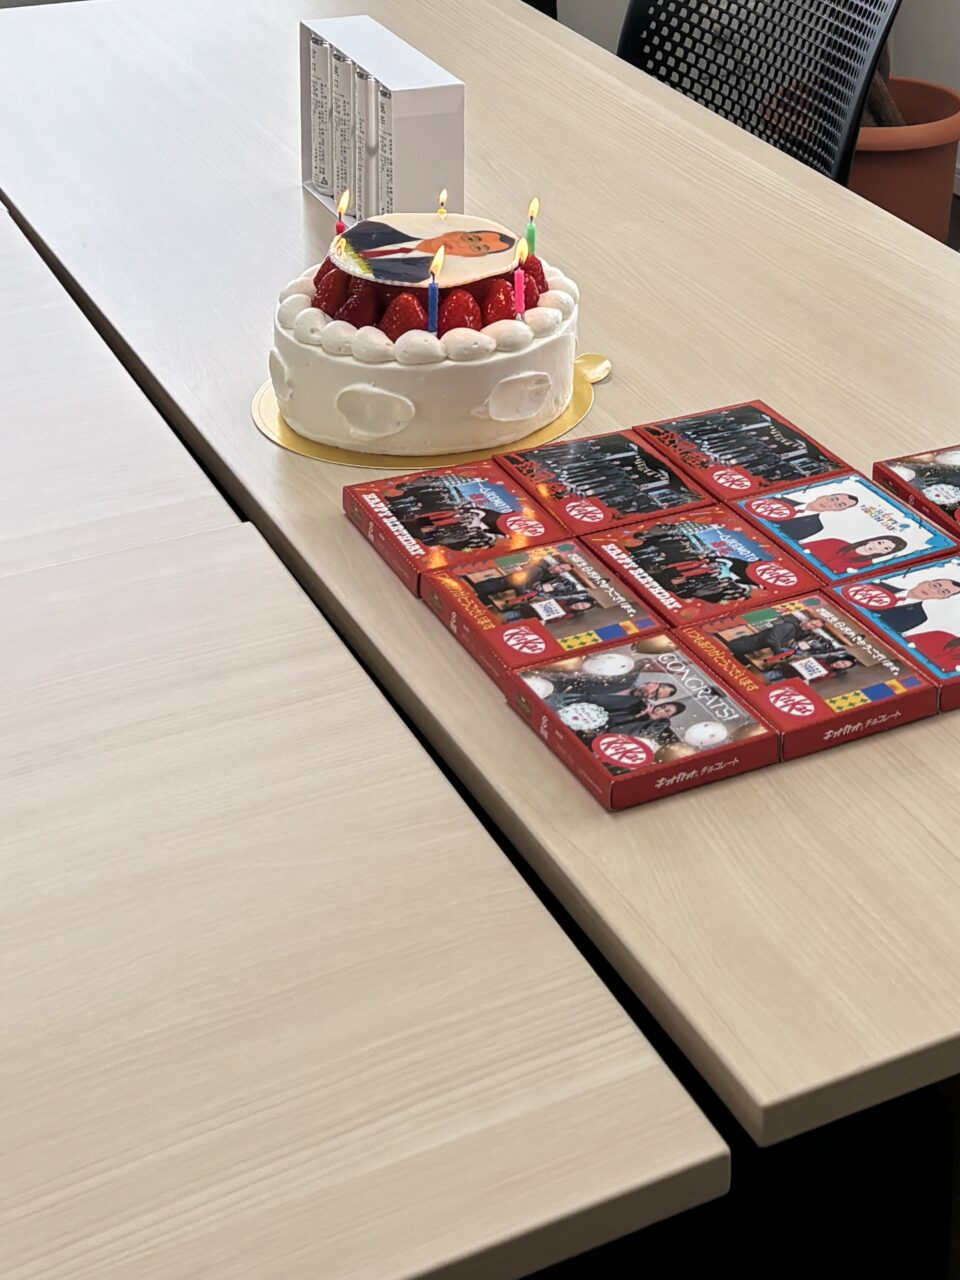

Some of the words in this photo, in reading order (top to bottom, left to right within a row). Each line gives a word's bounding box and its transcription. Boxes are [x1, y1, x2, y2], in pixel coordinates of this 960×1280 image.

[566, 501, 604, 522] KitKat
[756, 564, 798, 587] KitKat
[503, 628, 545, 654] KitKat
[657, 652, 740, 722] CONGRATS!
[768, 687, 815, 717] KitKat
[600, 736, 647, 765] KitKat
